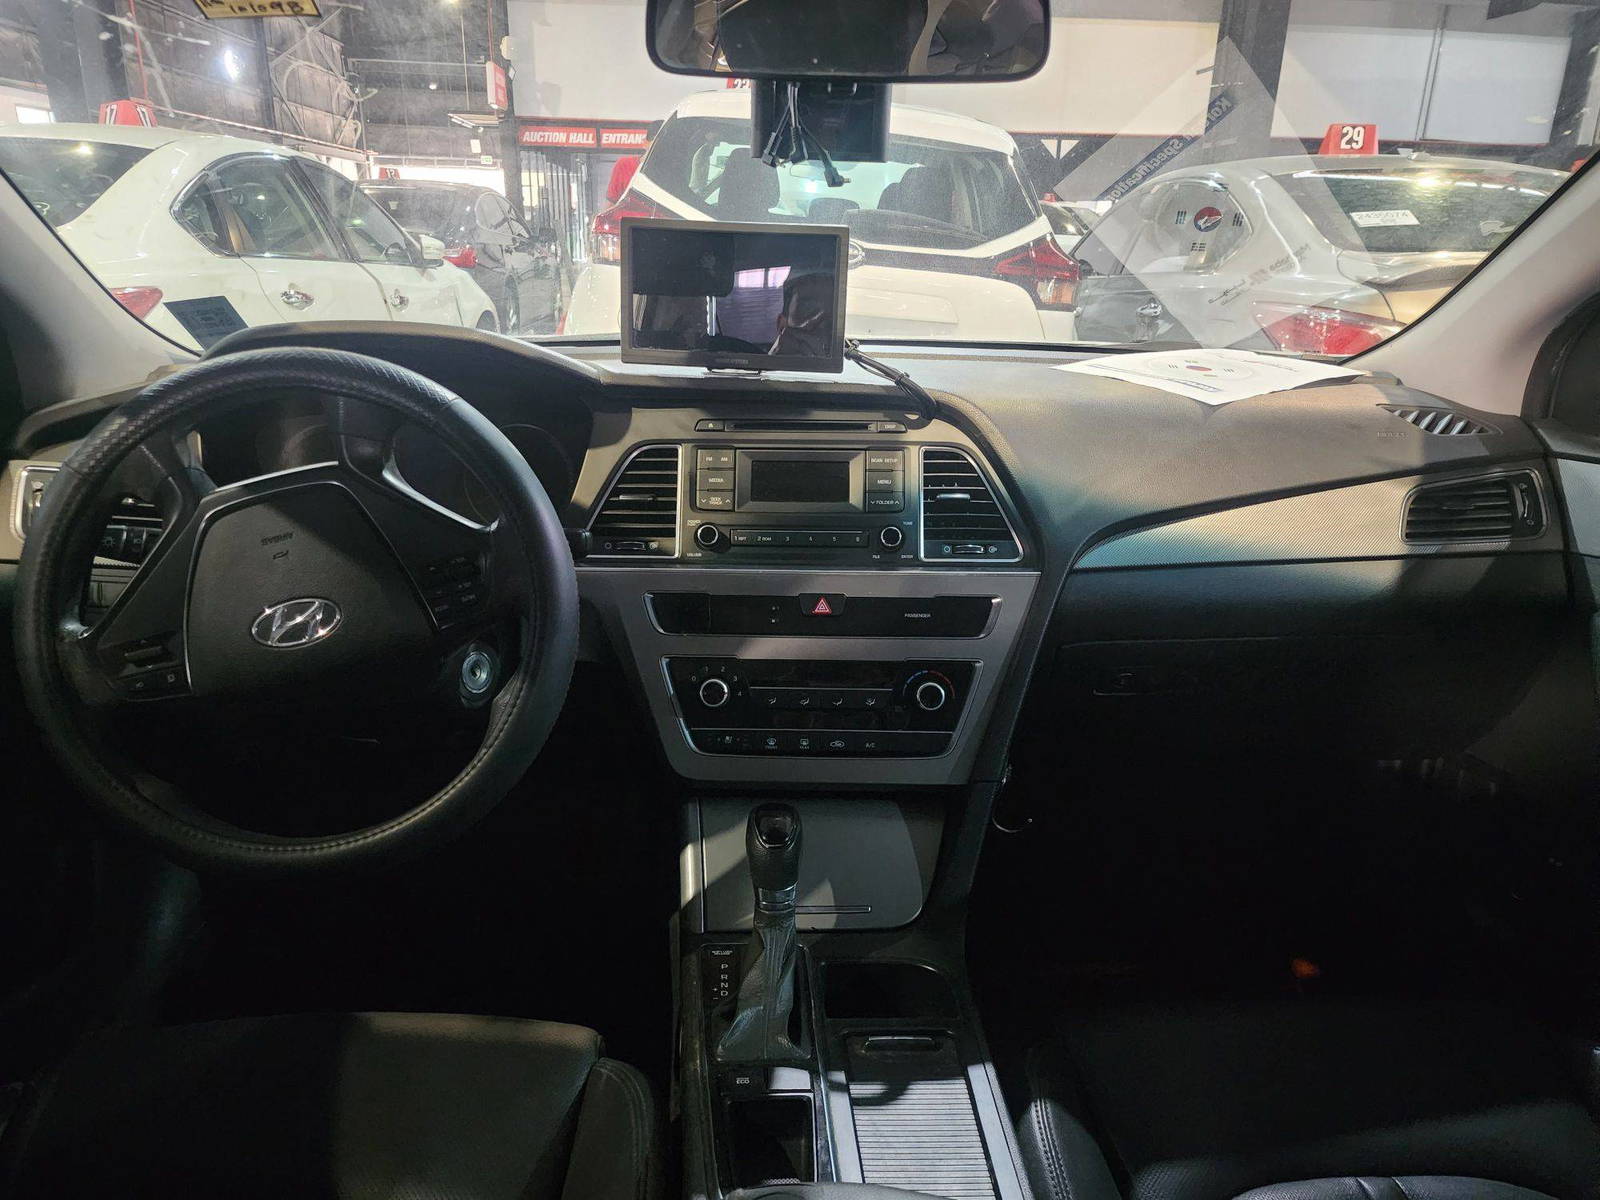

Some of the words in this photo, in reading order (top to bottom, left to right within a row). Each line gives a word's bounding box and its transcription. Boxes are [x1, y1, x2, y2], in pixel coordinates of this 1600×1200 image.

[522, 131, 567, 143] AUCTION
[568, 133, 595, 144] HALL
[1340, 126, 1365, 150] 29
